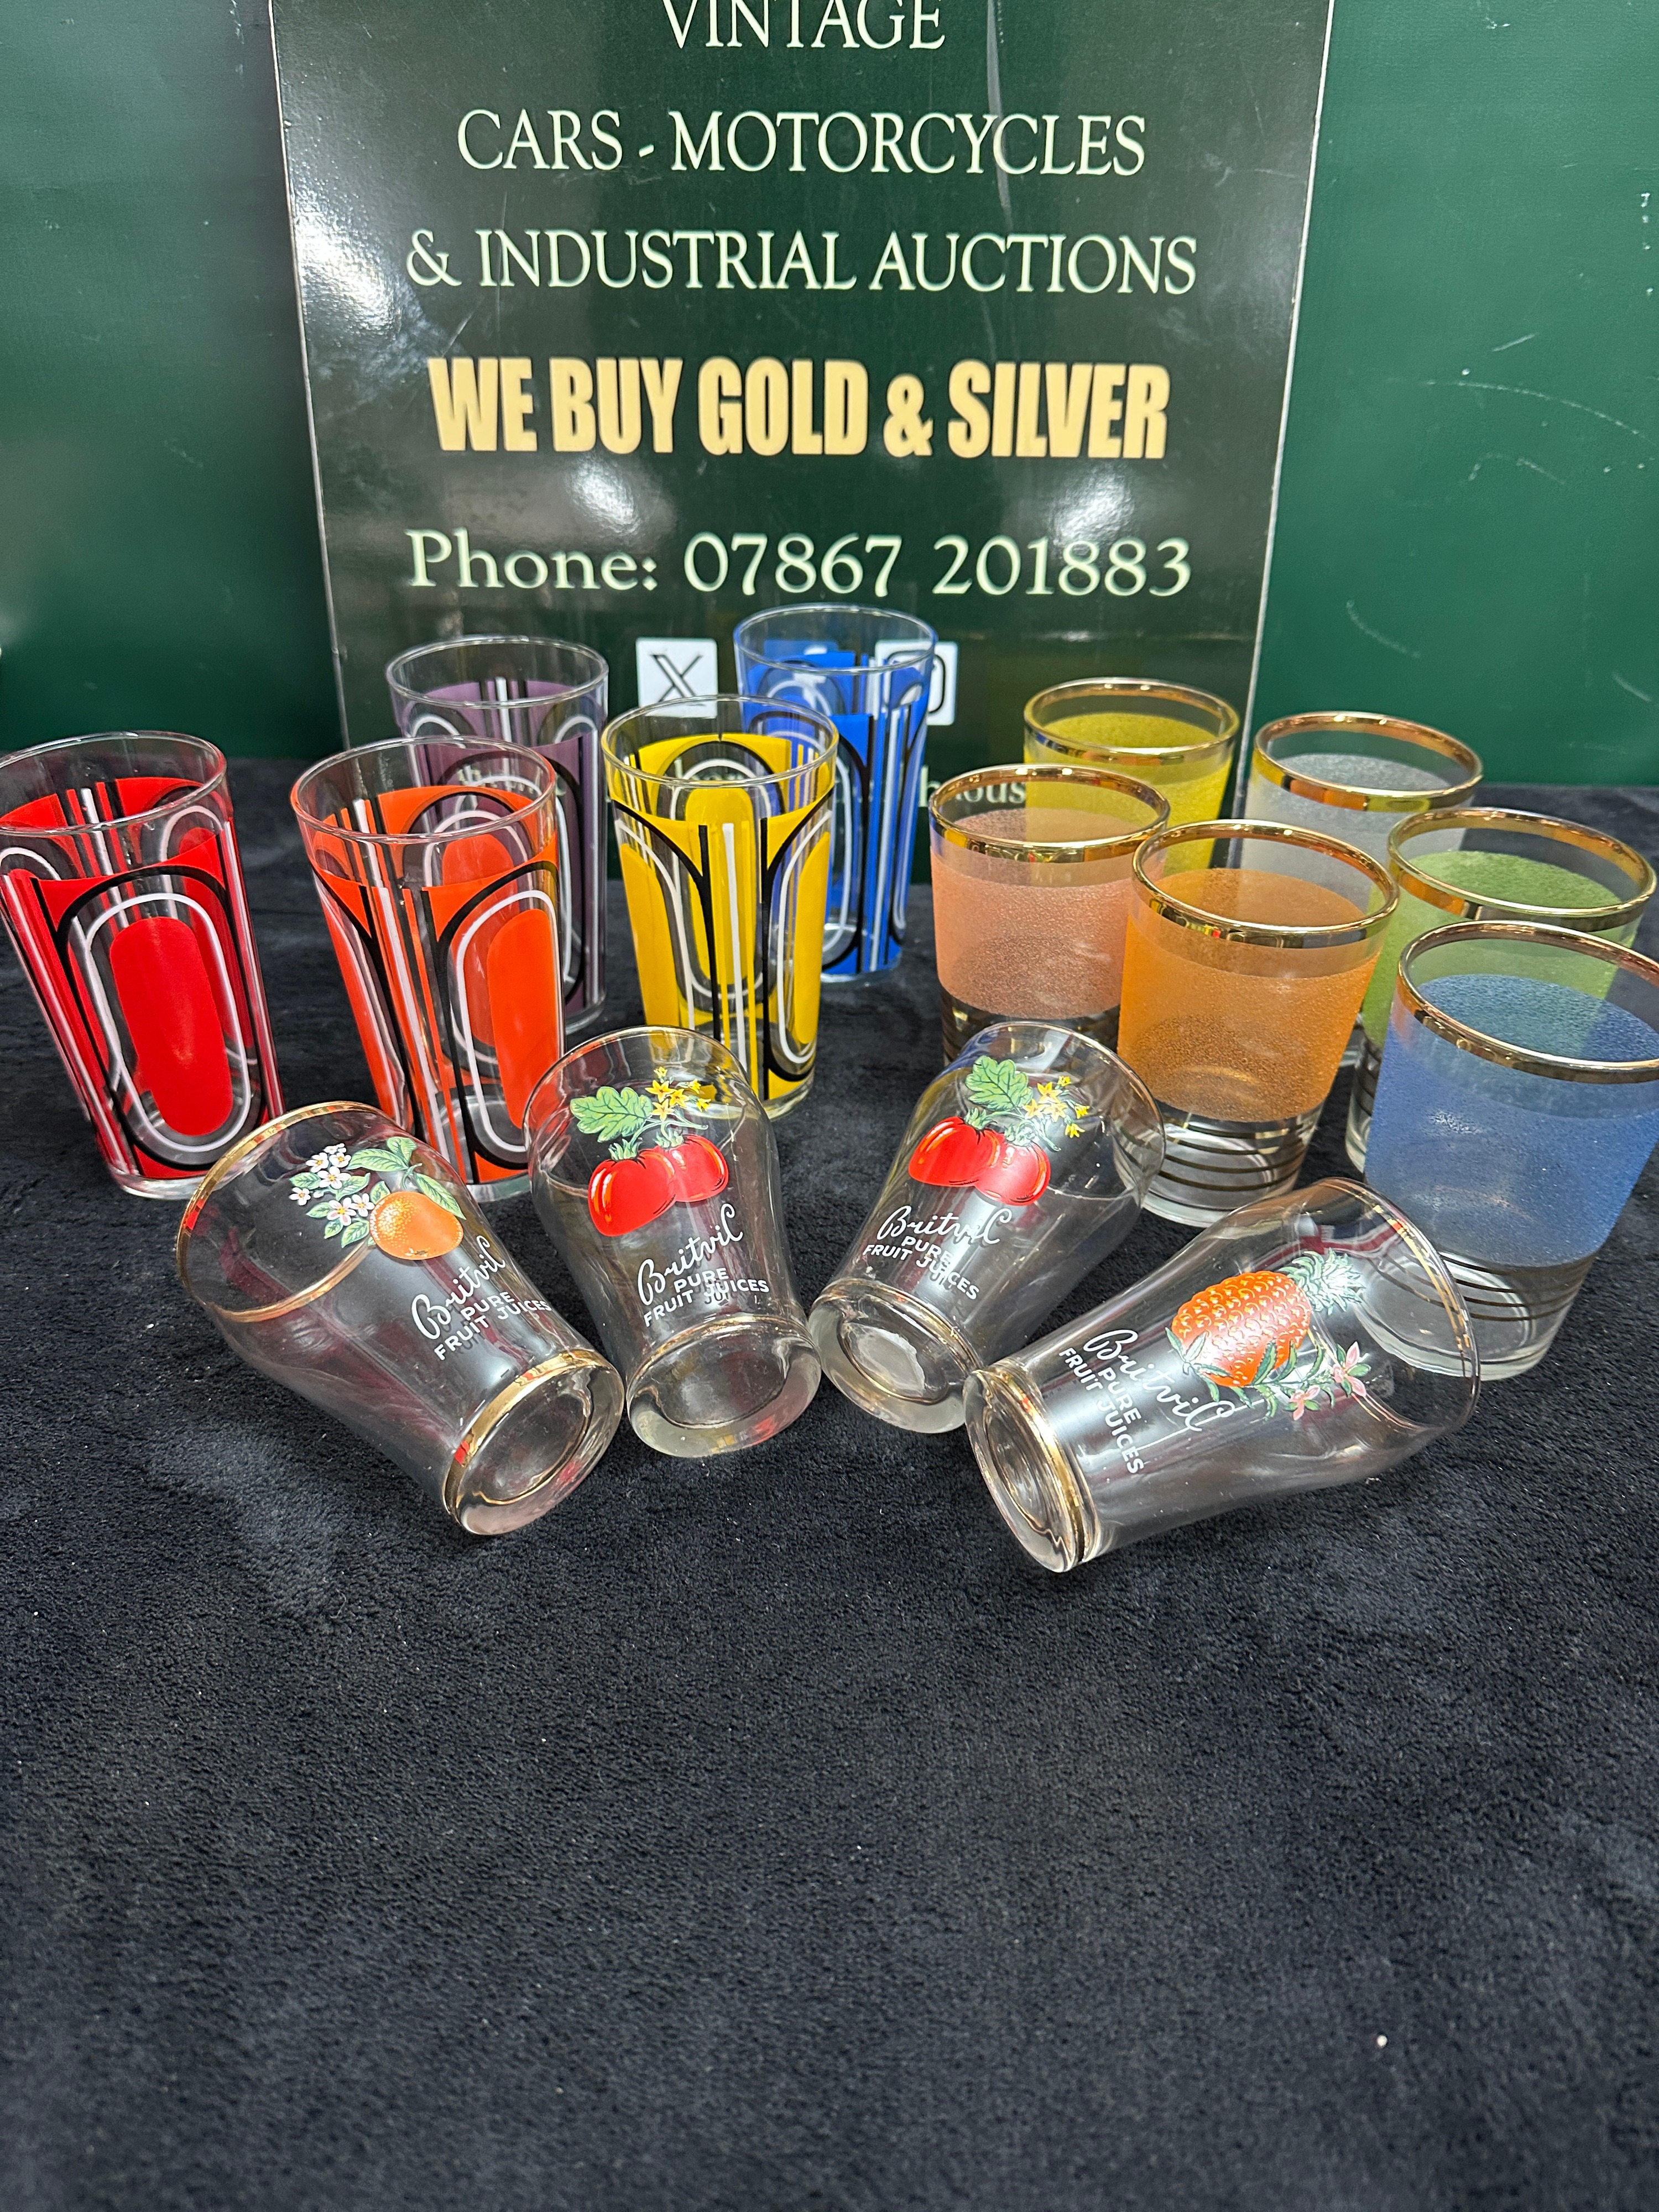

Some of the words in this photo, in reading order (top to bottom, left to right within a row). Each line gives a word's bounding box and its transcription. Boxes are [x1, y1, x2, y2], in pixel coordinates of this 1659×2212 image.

[662, 0, 946, 49] VINTAGE
[457, 108, 624, 172] CARS
[667, 110, 1146, 177] MOTORCYCLES
[404, 229, 461, 289] &
[478, 228, 857, 291] INDUSTRIAL
[868, 231, 1198, 296] AUCTIONS
[427, 356, 537, 453] WE
[548, 357, 684, 455] BUY
[697, 357, 869, 457] GOLD
[883, 374, 933, 458] &
[947, 359, 1171, 460] SILVER
[404, 526, 658, 591] Phone:
[684, 533, 902, 598] 07867
[932, 533, 1191, 597] 201883
[863, 1244, 913, 1261] FRUIT
[901, 1235, 954, 1264] PURE
[460, 1291, 515, 1321] PURE
[643, 1290, 693, 1327] FRUIT
[703, 1279, 769, 1297] JUICES
[674, 1267, 729, 1293] PURE
[434, 1315, 489, 1360] FRUIT
[497, 1300, 552, 1320] JUICES
[1058, 1347, 1104, 1391] FRUIT
[1096, 1397, 1145, 1474] JUICES
[1098, 1367, 1142, 1425] PURE
